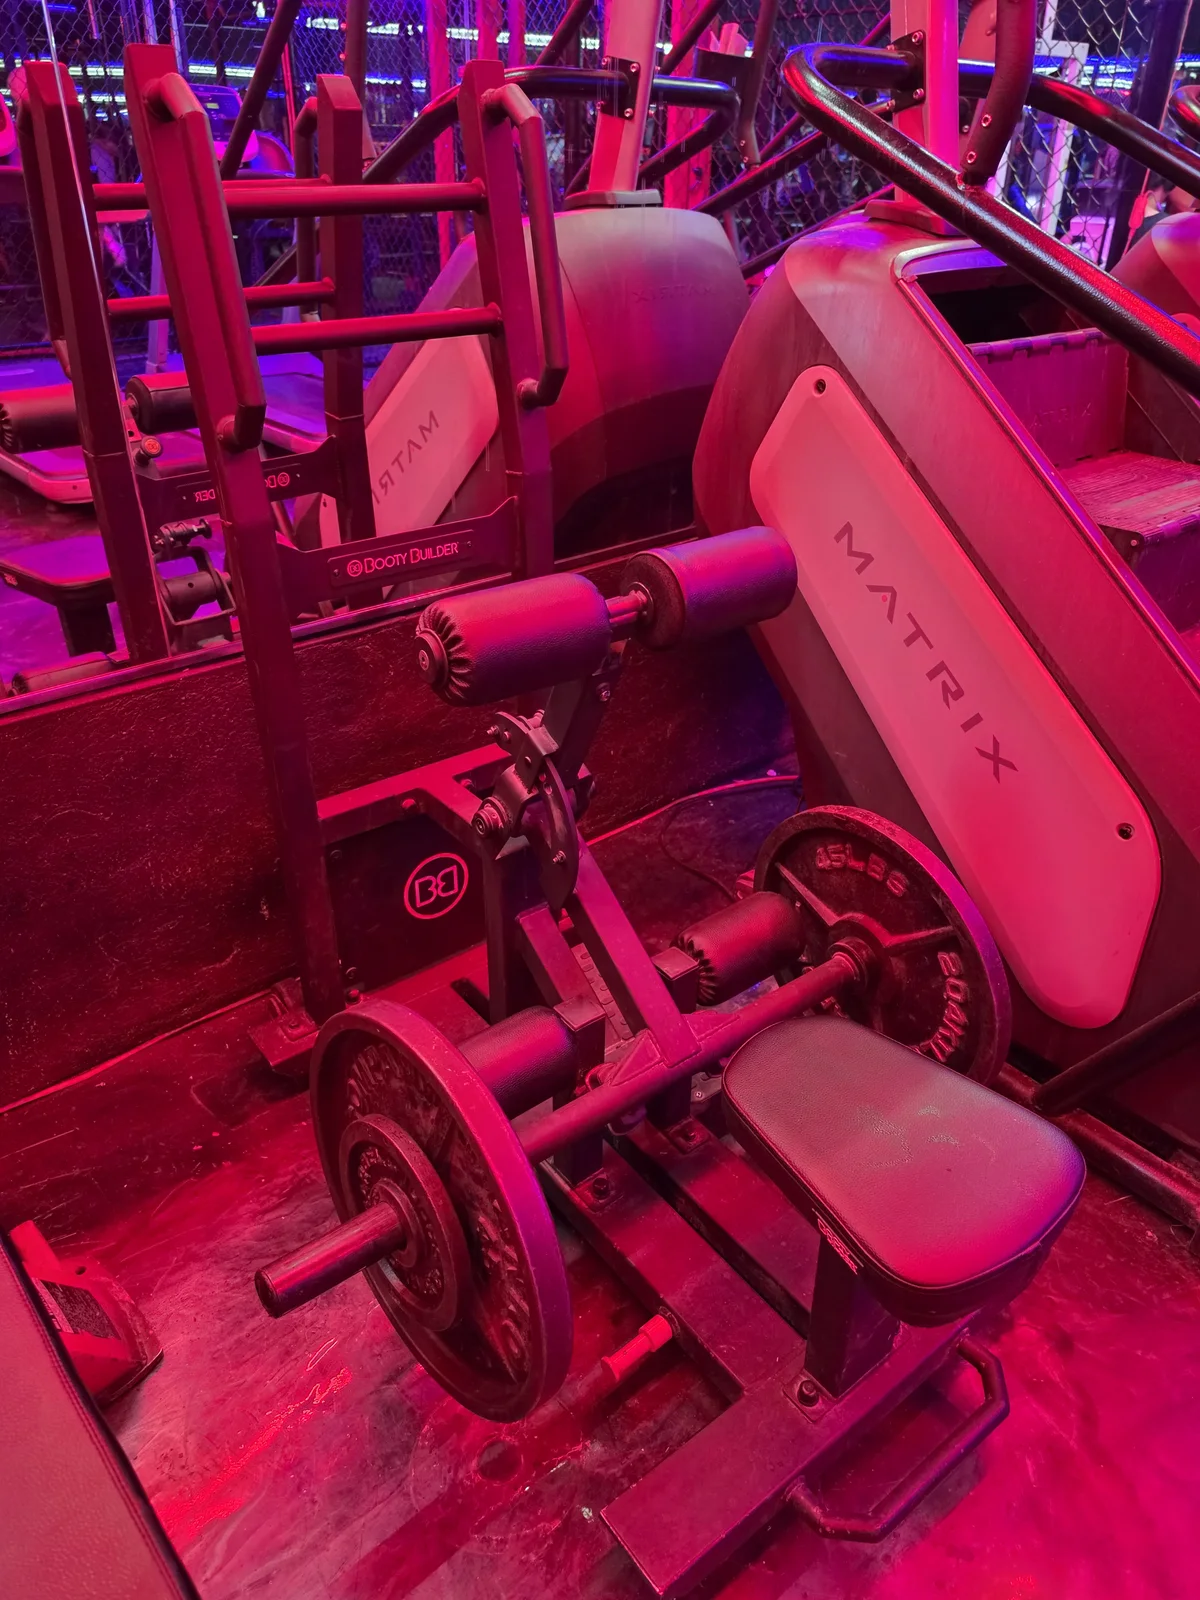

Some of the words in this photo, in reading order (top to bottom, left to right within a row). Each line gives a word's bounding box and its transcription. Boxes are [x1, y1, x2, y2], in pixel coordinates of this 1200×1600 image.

[363, 552, 408, 574] BOOTY
[409, 542, 459, 564] BUILDER
[833, 521, 1019, 784] MATRIX
